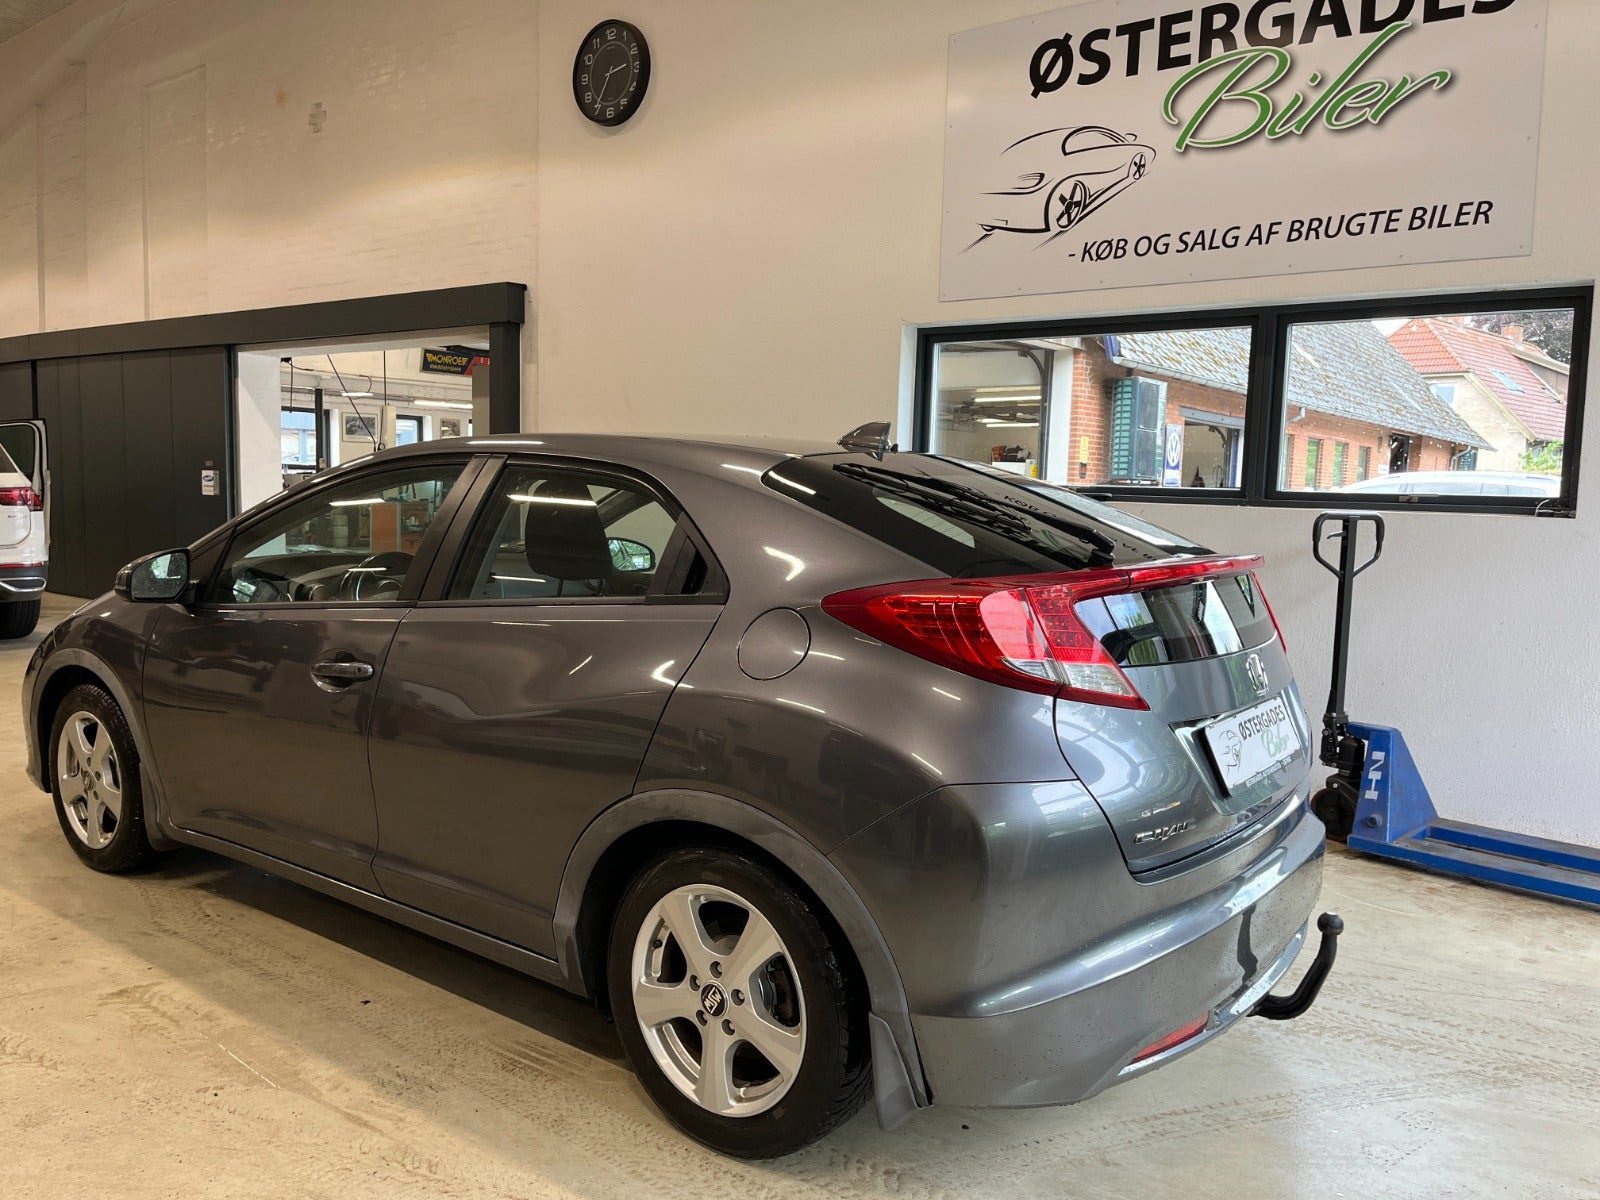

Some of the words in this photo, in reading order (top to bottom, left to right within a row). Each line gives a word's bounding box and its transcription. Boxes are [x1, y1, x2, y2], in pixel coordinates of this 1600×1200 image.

[606, 28, 617, 40] 12
[622, 30, 627, 41] 1
[592, 37, 600, 49] 11
[630, 43, 638, 54] 2
[1029, 0, 1516, 99] ØSTERGAD
[583, 53, 593, 65] 10
[581, 74, 589, 85] 9
[1162, 21, 1451, 152] Biler
[584, 92, 592, 103] 8
[606, 107, 615, 118] 6
[1080, 238, 1128, 262] KØB
[1133, 233, 1171, 257] OG
[1175, 226, 1241, 254] SALG
[1244, 221, 1283, 247] AF
[1286, 208, 1403, 243] BRUGTE
[1407, 200, 1494, 231] BILER
[427, 353, 466, 366] MONROE
[1238, 705, 1286, 740] ØSTERGADES
